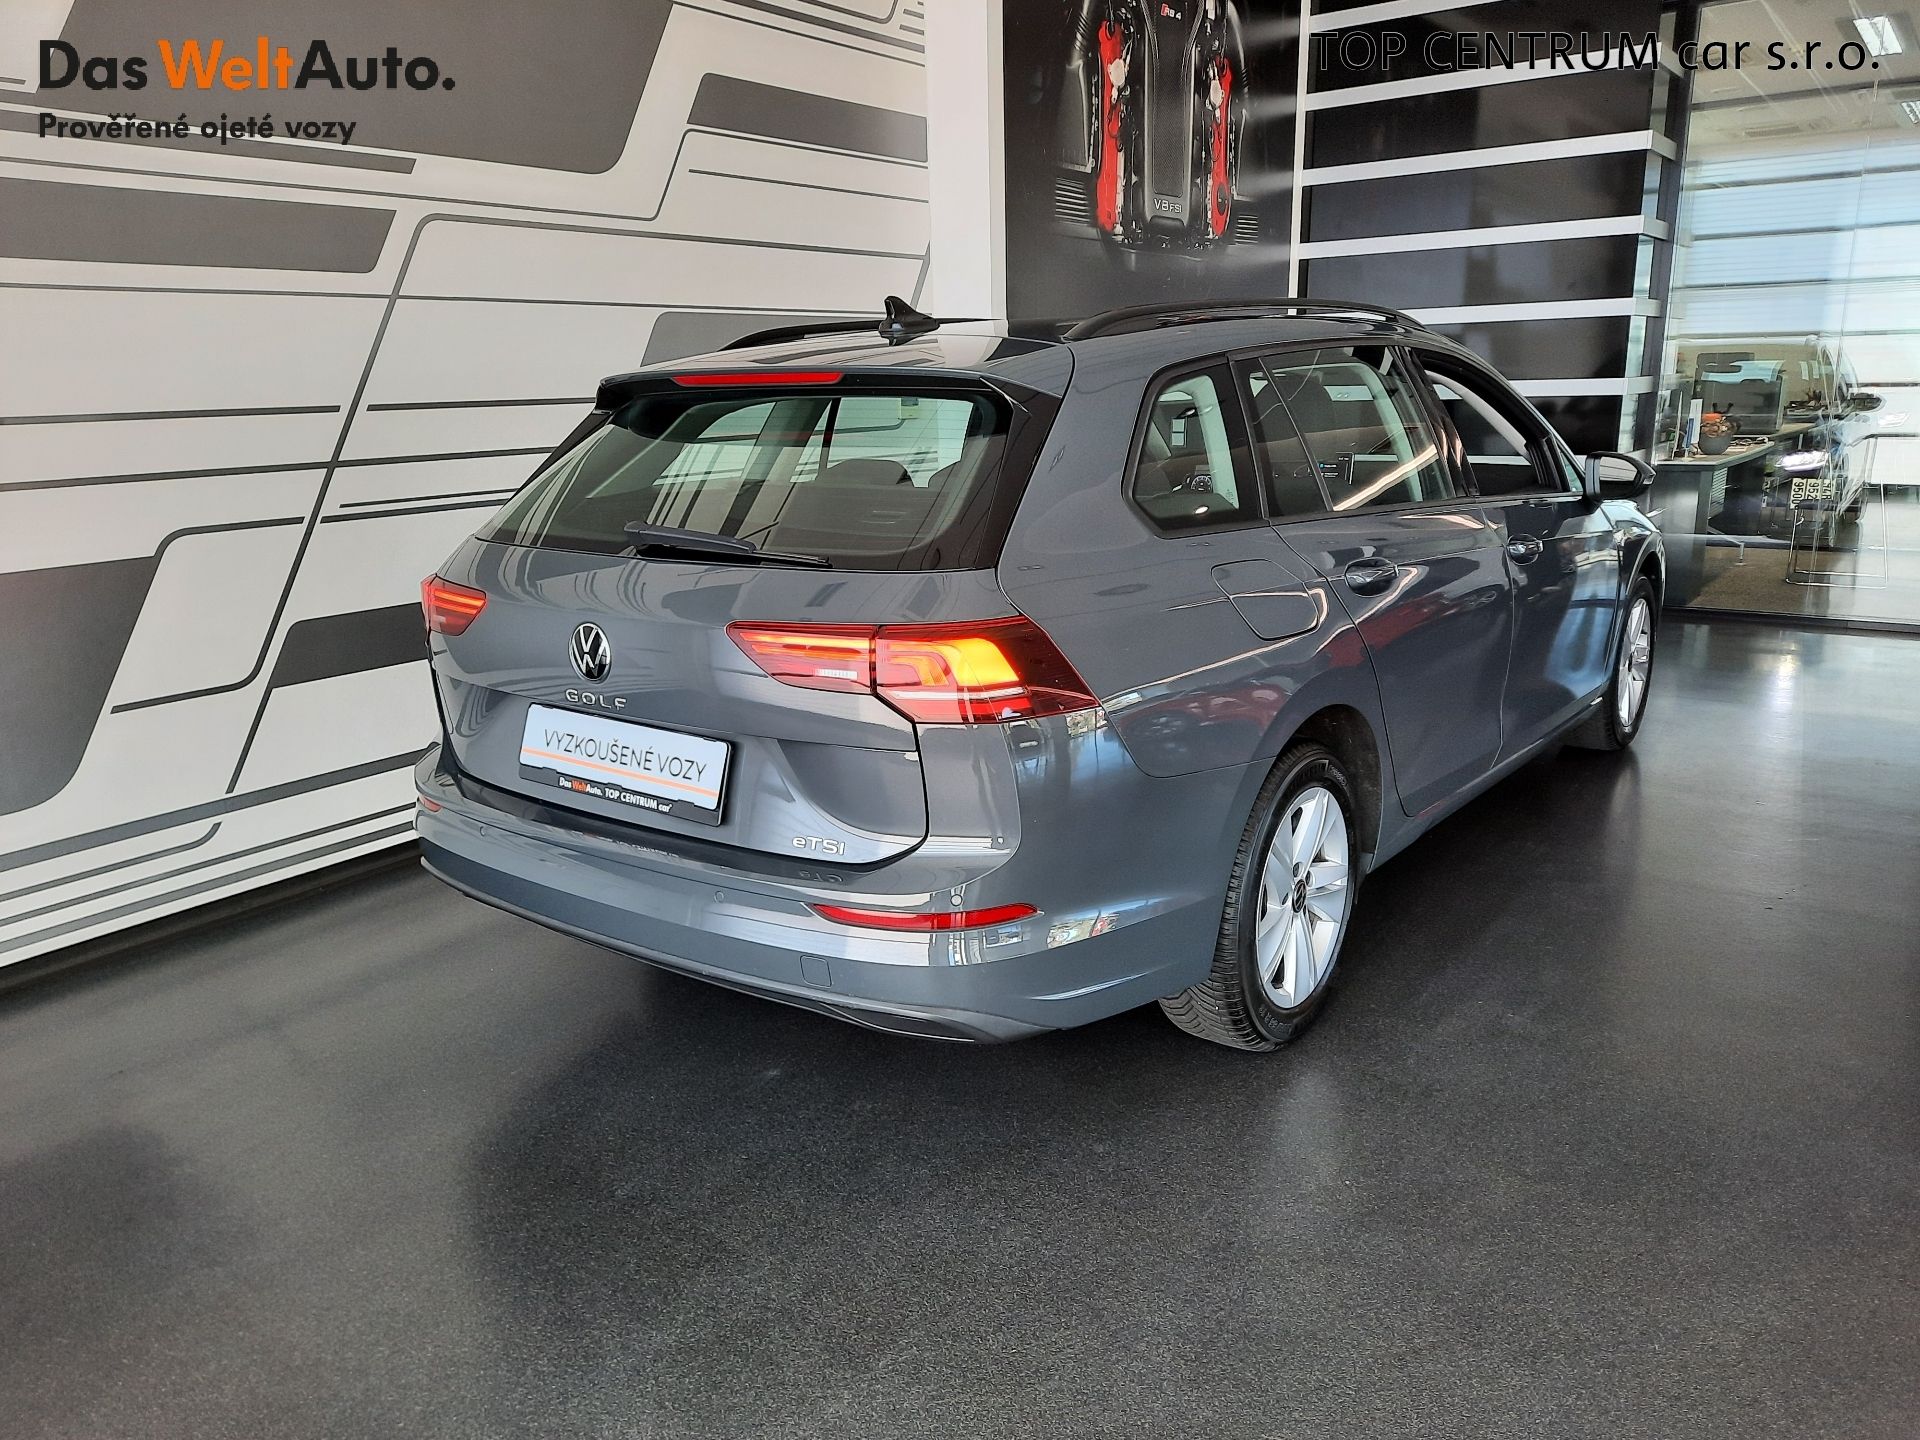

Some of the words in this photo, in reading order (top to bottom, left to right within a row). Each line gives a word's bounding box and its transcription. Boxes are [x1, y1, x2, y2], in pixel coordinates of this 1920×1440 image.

[565, 688, 627, 711] GOLF
[544, 728, 655, 772] VYZKOUŠENÉ
[657, 752, 707, 783] VOZY
[559, 776, 572, 788] Das
[604, 787, 620, 800] TOP
[620, 792, 658, 810] CENTRUM
[792, 836, 845, 856] eTSI
